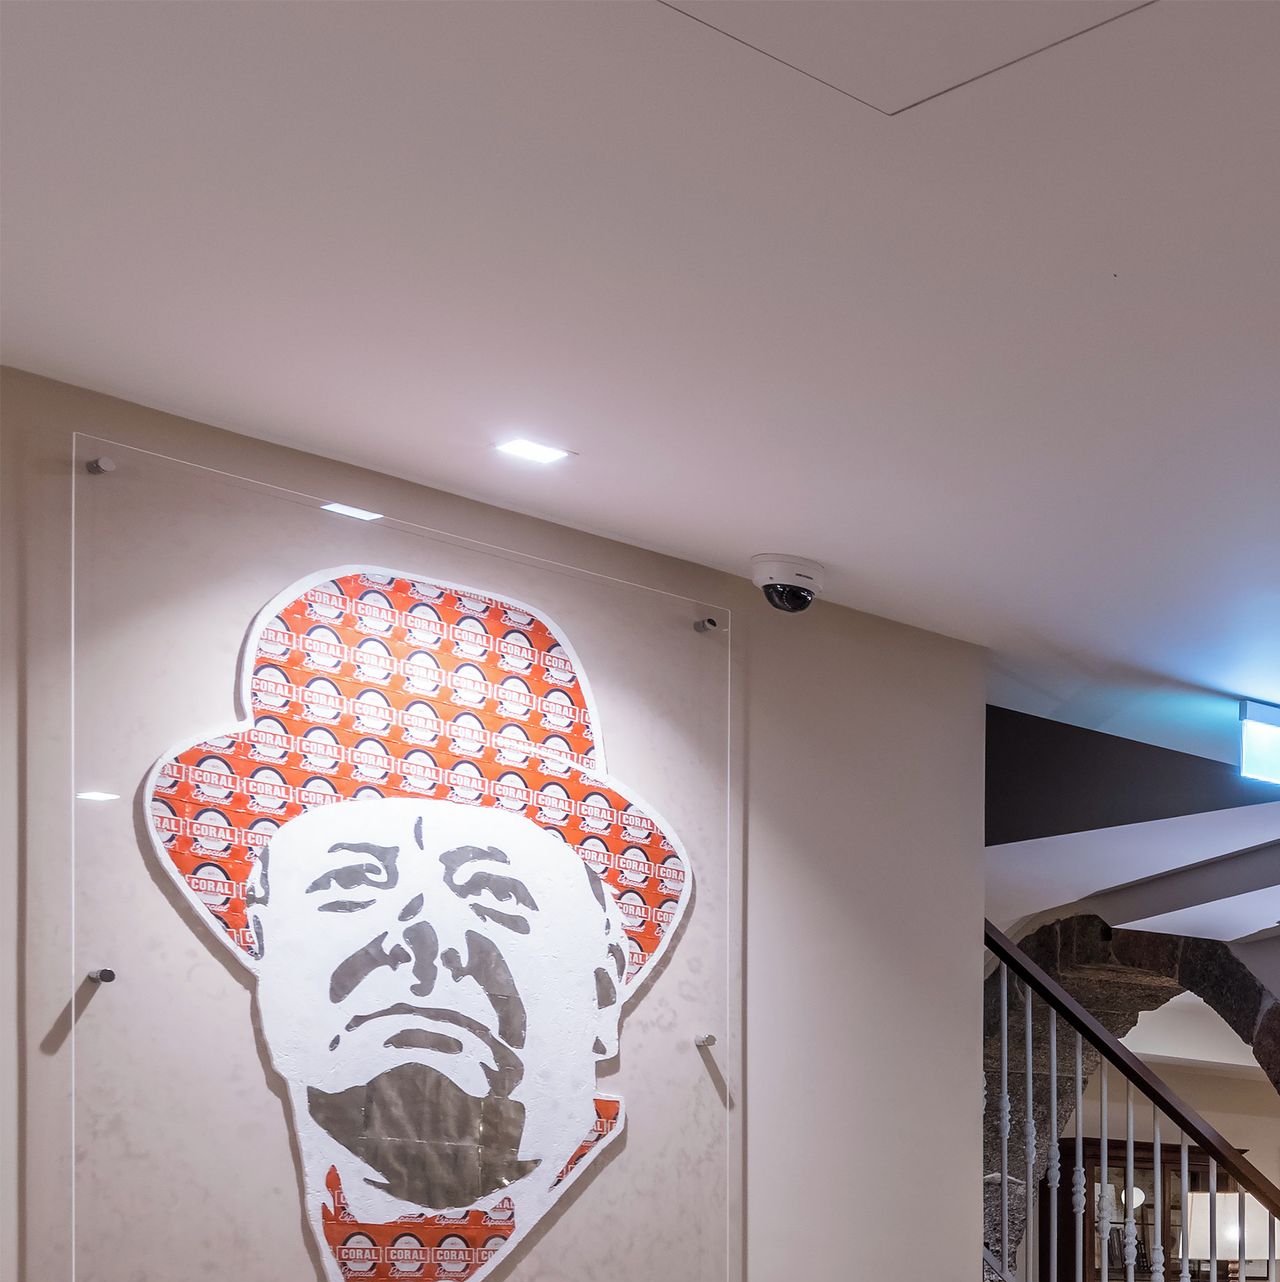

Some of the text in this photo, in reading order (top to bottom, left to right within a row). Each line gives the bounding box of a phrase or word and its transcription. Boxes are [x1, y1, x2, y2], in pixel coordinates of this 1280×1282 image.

[308, 590, 345, 608] CORAL
[359, 603, 394, 622] CORAL
[407, 616, 442, 634] CORAL
[261, 630, 291, 648] ORAL
[454, 628, 488, 646] CORAL
[305, 639, 342, 657] CORAL
[500, 642, 533, 660] CORAL
[355, 652, 392, 670] CORAL
[545, 656, 571, 670] CORA
[405, 664, 440, 682] CORAL
[252, 680, 290, 698] CORAL
[453, 676, 487, 694] CORAL
[304, 692, 342, 710] CORAL
[498, 690, 532, 707] CORAL
[355, 703, 392, 721] CORAL
[543, 702, 575, 719] CORAL
[403, 714, 440, 732] CORAL
[251, 731, 290, 748] CORAL
[451, 725, 485, 743] CORAL
[302, 740, 340, 758] CORAL
[352, 752, 390, 769] CORAL
[194, 771, 235, 788] CORAL
[402, 762, 439, 780] CORAL
[449, 773, 484, 790] CORAL
[249, 782, 288, 799] CORAL
[495, 784, 529, 801] CORAL
[538, 796, 572, 813] CORAL
[581, 805, 613, 821] CORAL
[154, 817, 178, 830] RAL
[622, 815, 652, 829] CORAL
[192, 823, 233, 840] CORAL
[248, 832, 272, 846] COR
[579, 849, 610, 865] CORAL
[620, 858, 650, 873] CORAL
[660, 868, 685, 880] CORA
[191, 878, 232, 894] CORAL
[342, 1250, 377, 1259] CORAL
[391, 1250, 425, 1260] CORAL
[437, 1251, 470, 1260] CORAL
[389, 1267, 423, 1277] Especial
